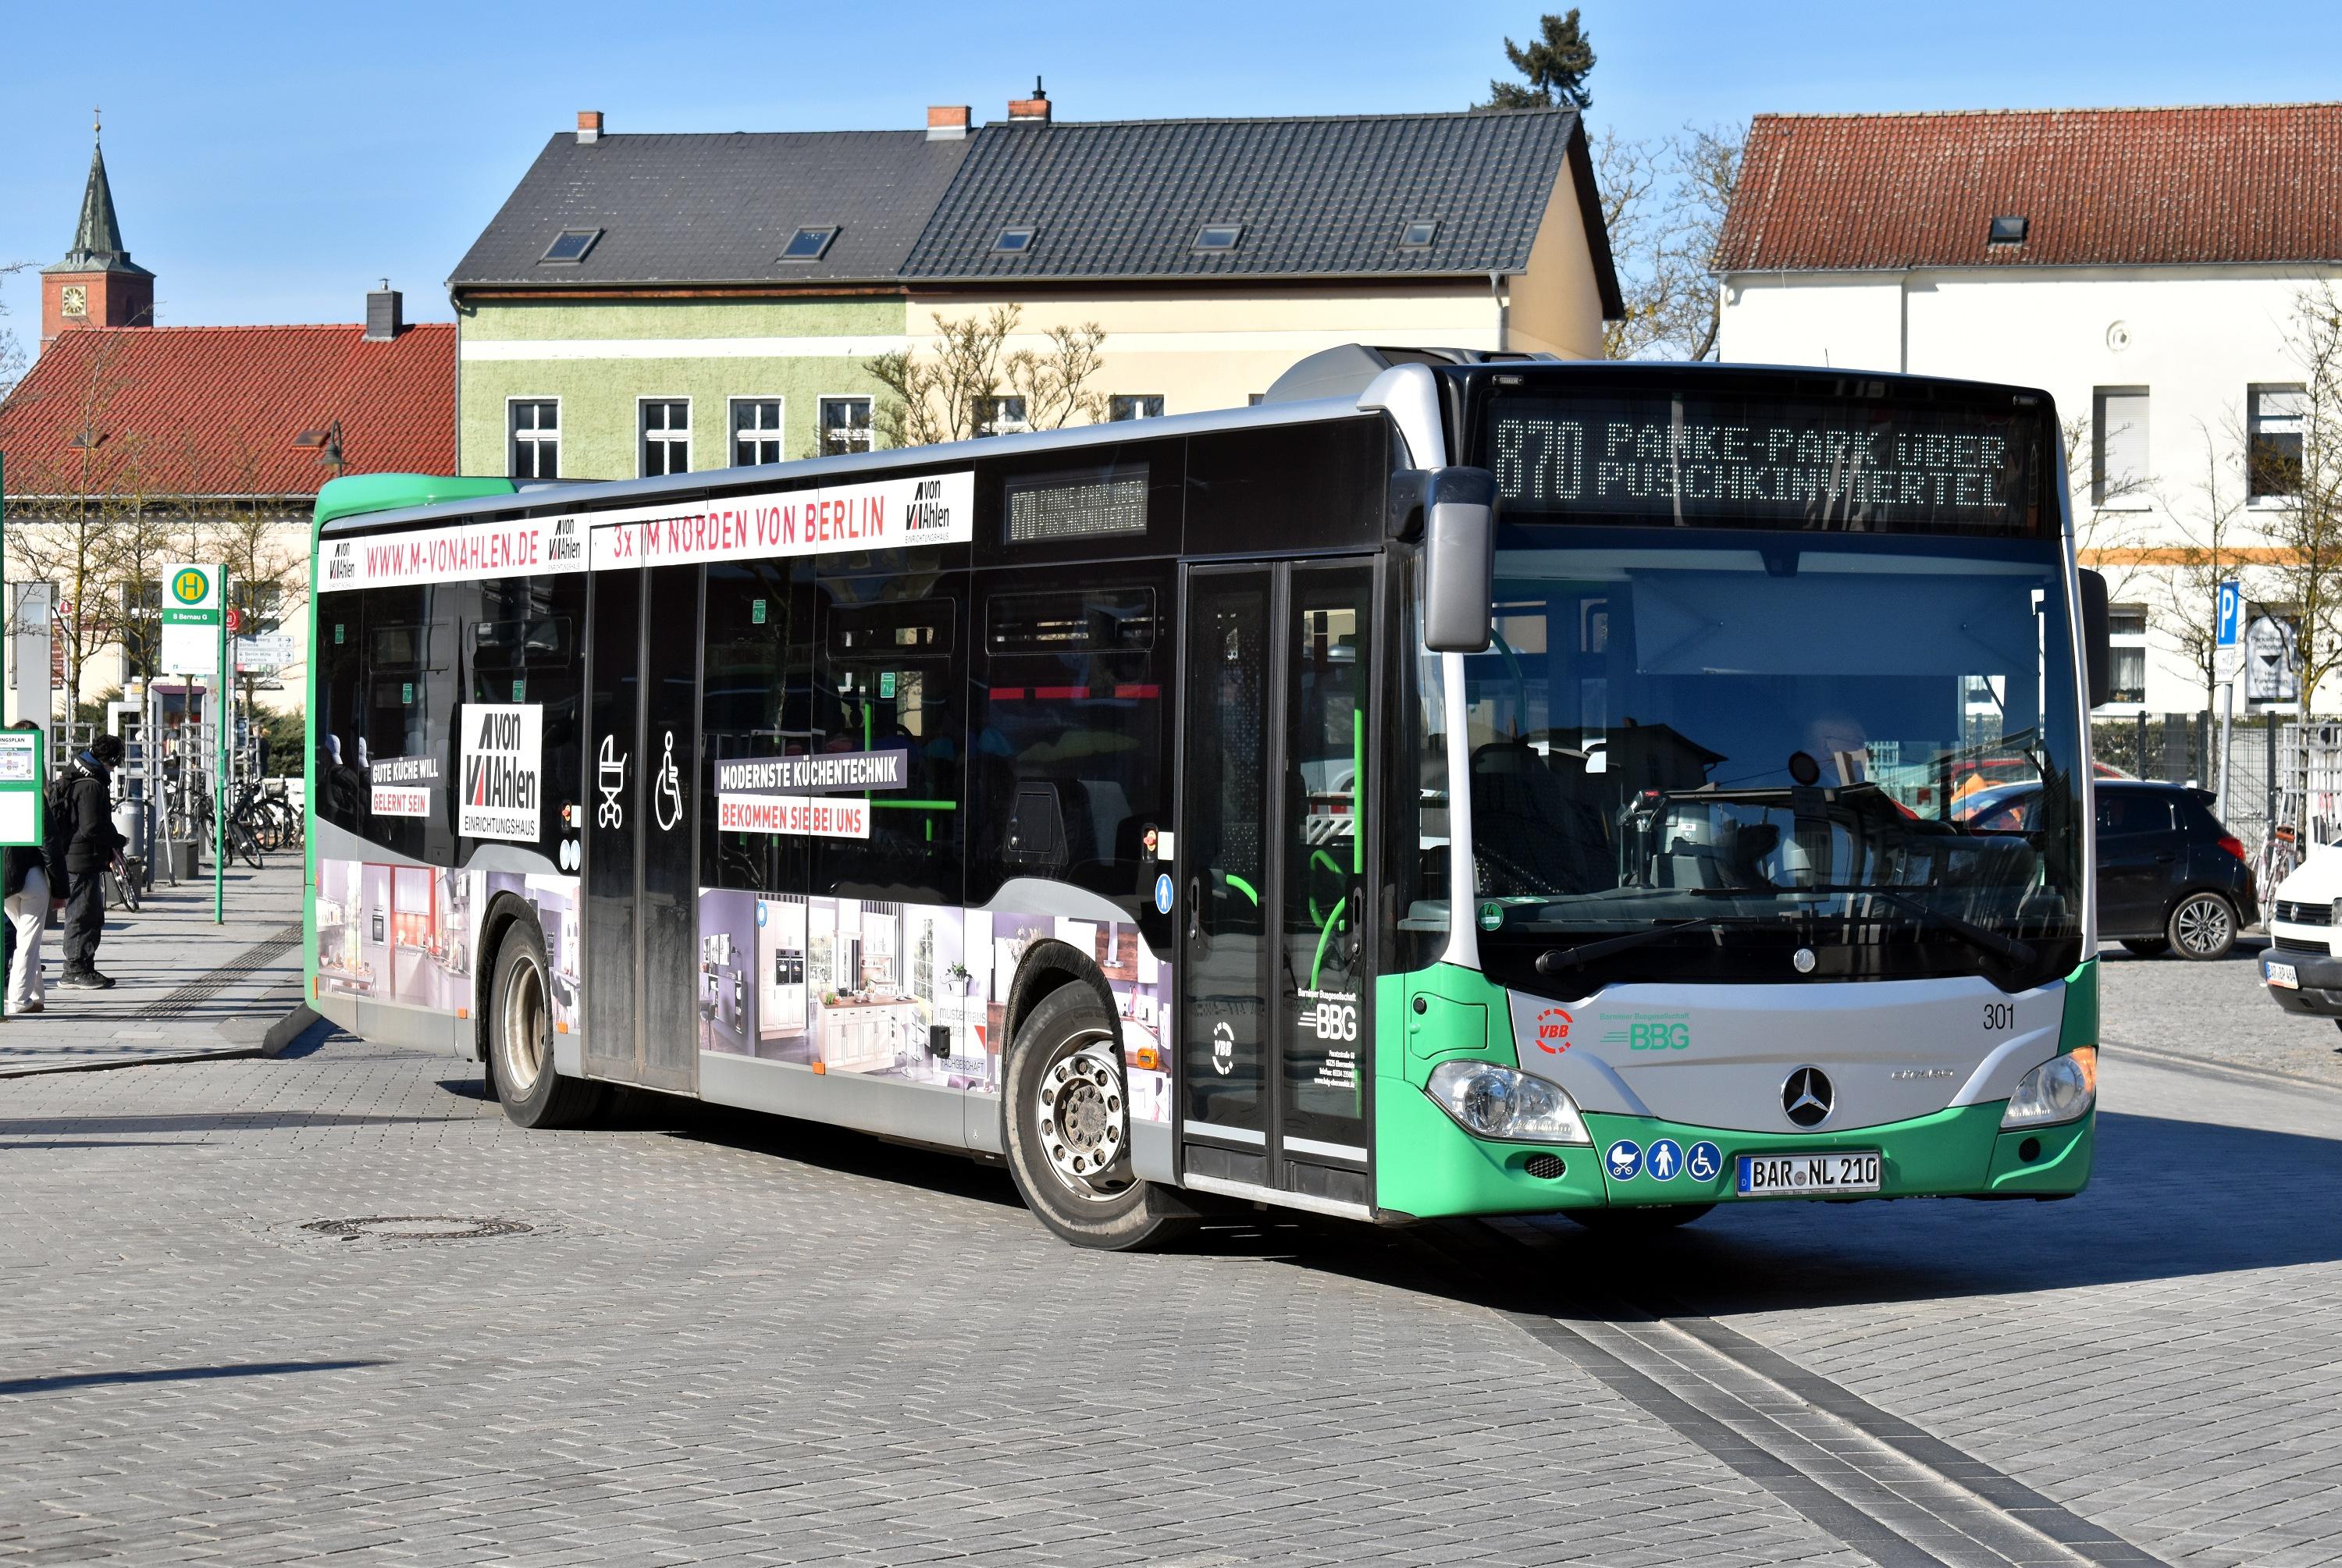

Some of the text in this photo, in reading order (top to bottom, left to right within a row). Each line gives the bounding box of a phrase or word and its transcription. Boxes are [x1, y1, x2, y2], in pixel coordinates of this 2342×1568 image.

[1497, 419, 2005, 500] 870 PANKE-PARK ÜBER
[924, 479, 941, 500] von
[1598, 462, 2007, 507] PUSCHKINVIERTEL
[562, 517, 574, 535] von
[614, 496, 884, 558] 3x IM NORDEN VON BERLIN
[923, 503, 949, 529] Ahlen
[561, 536, 580, 560] Ahlen
[905, 532, 949, 544] EINRICHTUNGSHAUS
[367, 530, 539, 578] WWW.M-VONAHLEN.DE
[339, 560, 355, 578] Ahlen
[2221, 588, 2233, 638] P
[494, 713, 521, 751] von
[372, 757, 439, 783] GUTE KÜCHE WILL
[492, 756, 536, 809] Ahlen
[720, 755, 898, 790] MODERNSTE KÜCHENTECHNIK
[373, 794, 425, 812] GELERNT SEIN
[464, 816, 536, 836] EINRICHTUNGSHAUS
[722, 803, 861, 833] BEKOMMEN SIE BEI UNS
[1486, 904, 1494, 916] 4
[939, 1001, 986, 1023] musterhaus
[1316, 1003, 1357, 1042] BBG
[1634, 1012, 1690, 1022] Busgesellschaft
[1983, 1003, 2014, 1030] 301
[1539, 1024, 1569, 1038] VBB
[1629, 1022, 1690, 1051] BBG
[1214, 1040, 1233, 1057] VBB
[941, 1058, 984, 1072] FACHGESCHÄFT
[1753, 1161, 1792, 1187] BAR
[1809, 1159, 1835, 1185] NL
[1840, 1157, 1877, 1184] 210
